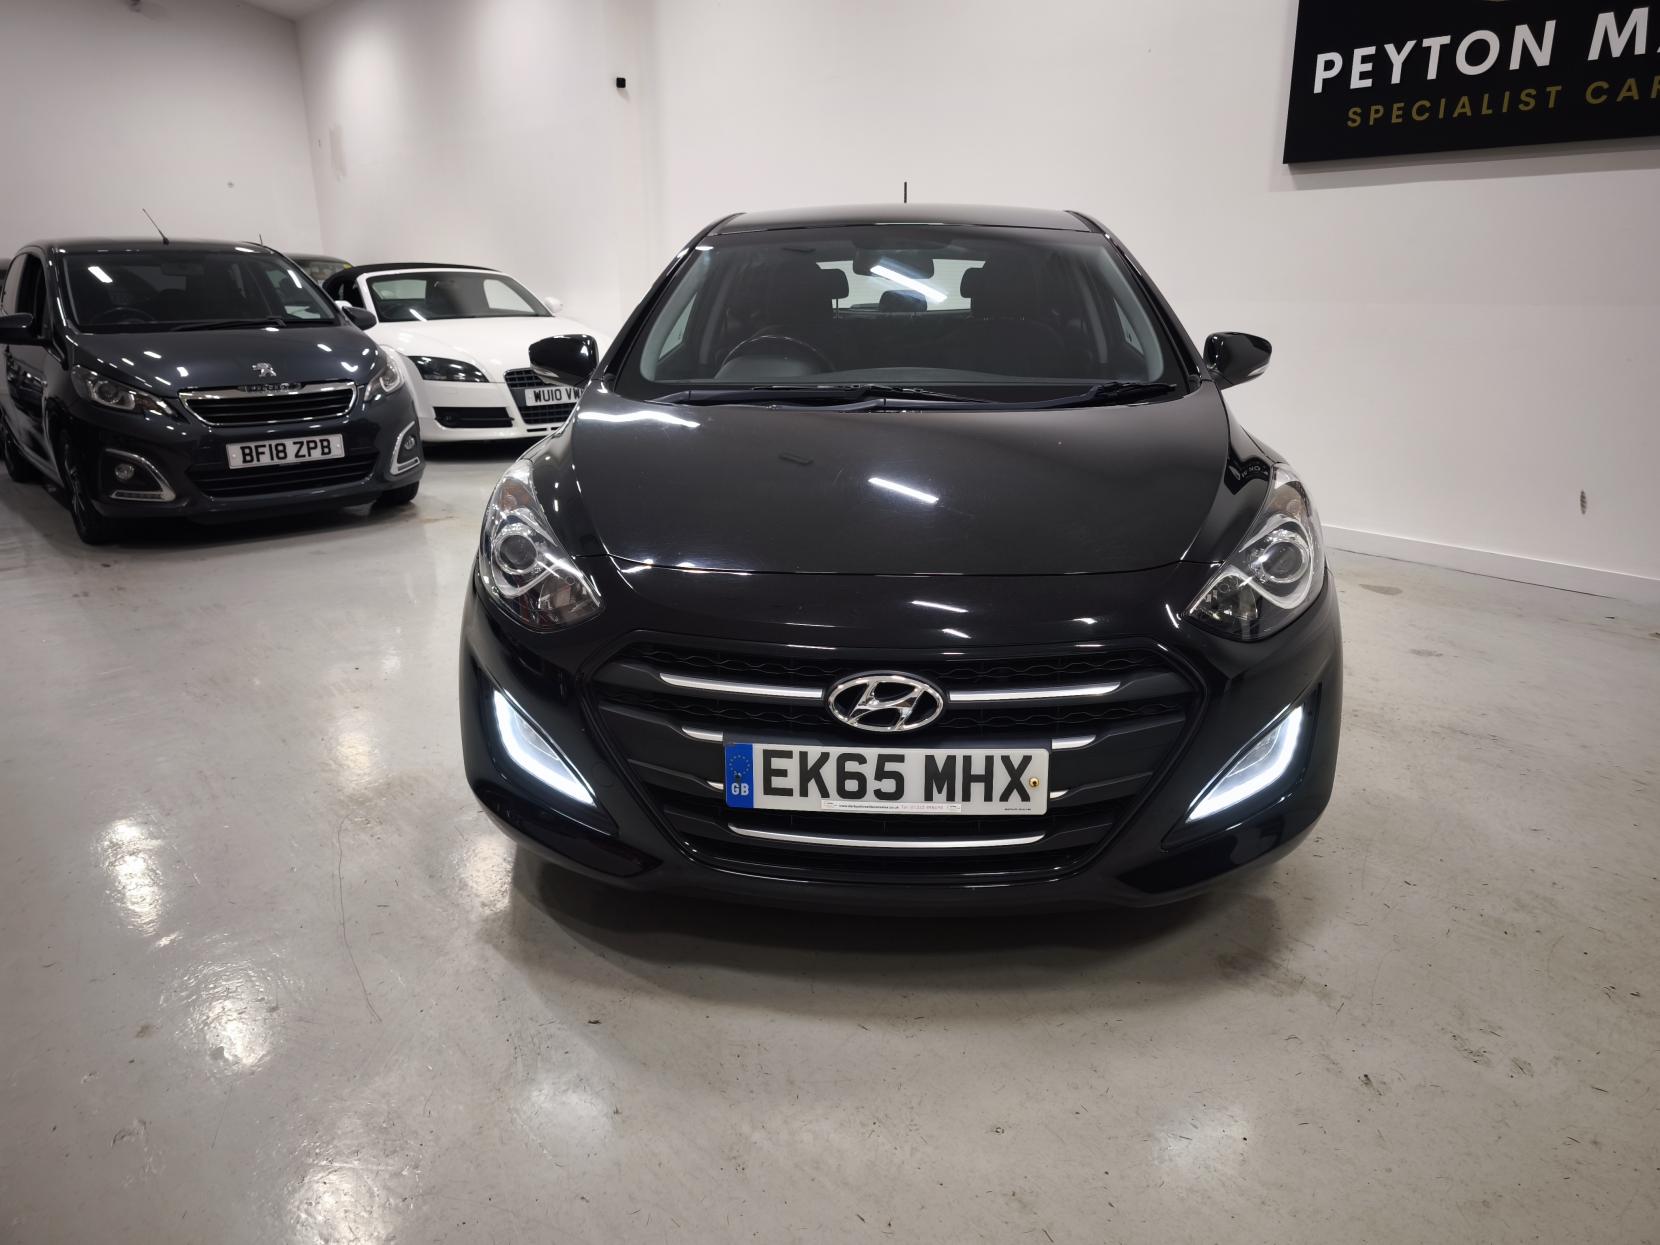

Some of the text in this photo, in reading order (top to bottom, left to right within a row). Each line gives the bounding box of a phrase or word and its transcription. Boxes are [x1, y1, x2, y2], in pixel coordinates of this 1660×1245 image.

[1313, 6, 1660, 94] PEYTON M
[1346, 85, 1562, 128] SPECIALIST
[533, 387, 584, 402] WU10 VW
[240, 438, 332, 464] BF18 ZPB
[731, 783, 749, 796] GB
[762, 749, 1033, 803] EK65 MHX
